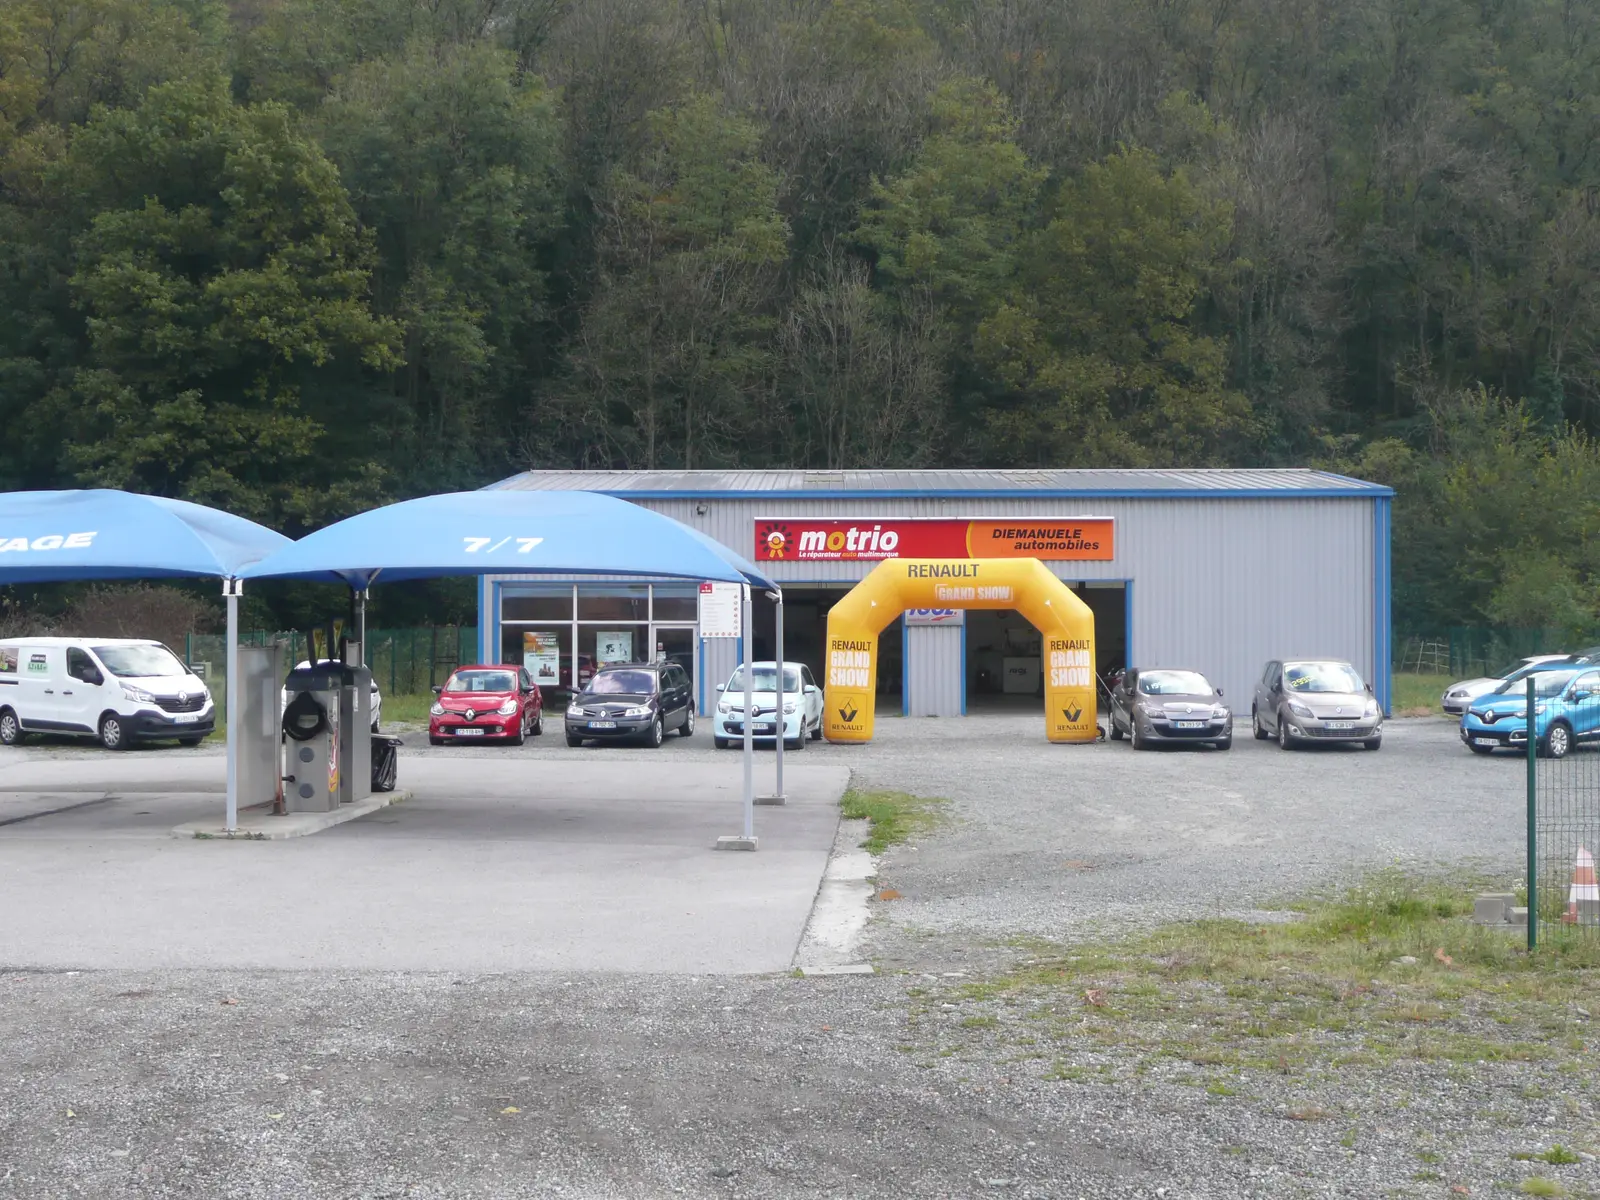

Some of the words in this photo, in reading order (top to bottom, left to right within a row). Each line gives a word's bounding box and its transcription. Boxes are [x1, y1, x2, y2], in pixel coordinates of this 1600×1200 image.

[798, 524, 899, 551] motrio
[992, 528, 1082, 539] DIEMANUELE
[1014, 539, 1100, 550] automobiles
[807, 550, 842, 559] réparateur
[857, 550, 899, 559] multimarque
[907, 564, 980, 578] RENAULT
[938, 586, 976, 600] GRAND
[977, 585, 1011, 600] SHOW
[831, 640, 872, 652] RENAULT
[1050, 639, 1090, 651] RENAULT
[831, 650, 871, 668] GRAND
[1050, 650, 1091, 668] GRAND
[830, 667, 870, 687] SHOW
[1050, 667, 1091, 687] SHOW
[831, 723, 864, 731] RENAULT
[1056, 723, 1089, 731] RENAULT
